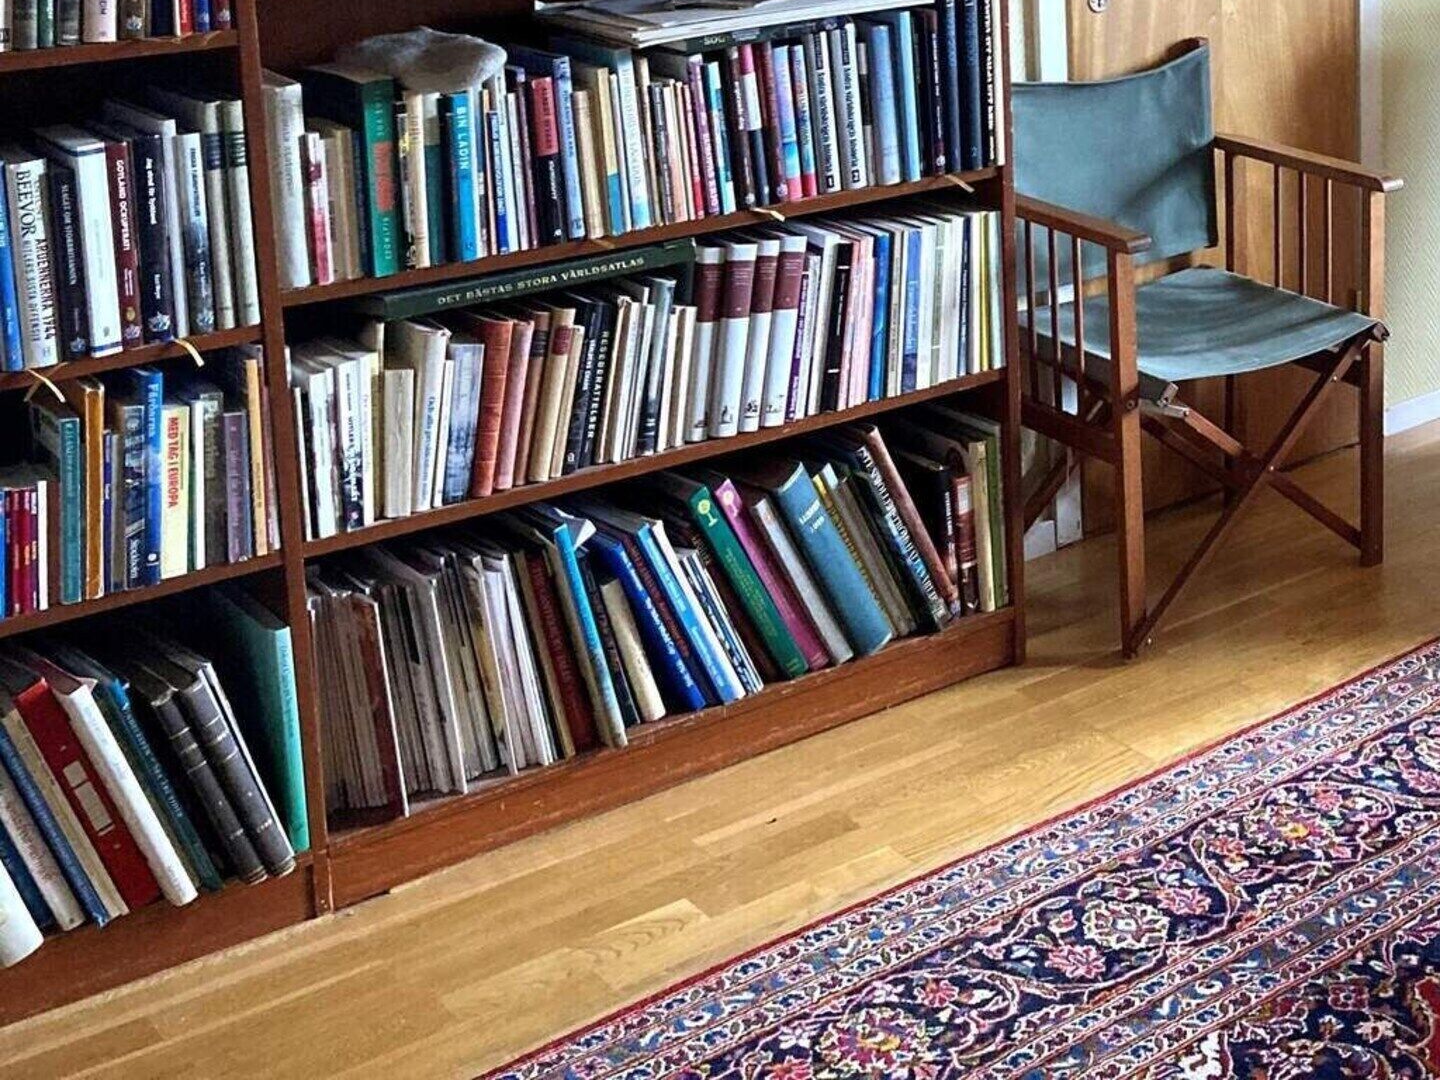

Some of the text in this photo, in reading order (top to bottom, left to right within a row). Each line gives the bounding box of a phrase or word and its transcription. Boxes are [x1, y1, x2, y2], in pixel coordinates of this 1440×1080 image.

[455, 106, 471, 169] BIN LADIN
[115, 159, 126, 198] GOTLAND
[15, 170, 35, 236] BEEVOR
[33, 238, 56, 339] ARDENNERNA 1944
[436, 255, 644, 305] DET BÄSTAS STORA VÄRLDSATLAS
[167, 417, 179, 438] MED
[168, 441, 180, 459] TÅG
[167, 467, 180, 507] EUROPA
